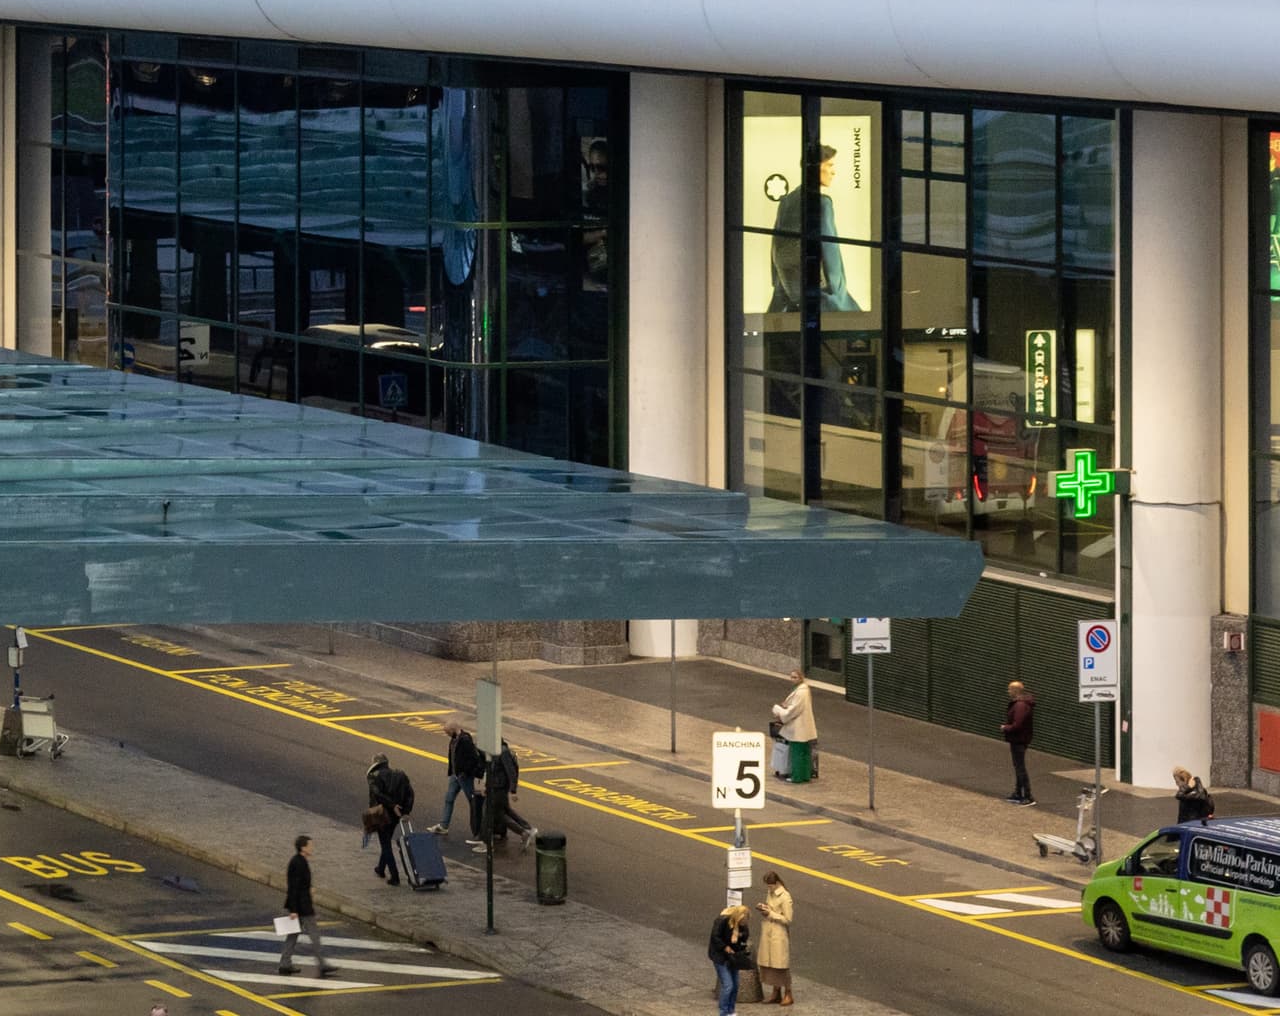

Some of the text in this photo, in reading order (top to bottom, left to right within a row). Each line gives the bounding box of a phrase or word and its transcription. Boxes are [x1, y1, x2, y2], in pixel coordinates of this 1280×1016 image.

[853, 127, 861, 189] MONTBLANC
[735, 760, 761, 799] 5
[543, 778, 697, 821] CARABINIERI
[1194, 843, 1240, 868] ViaMilano
[1249, 873, 1275, 888] Parking
